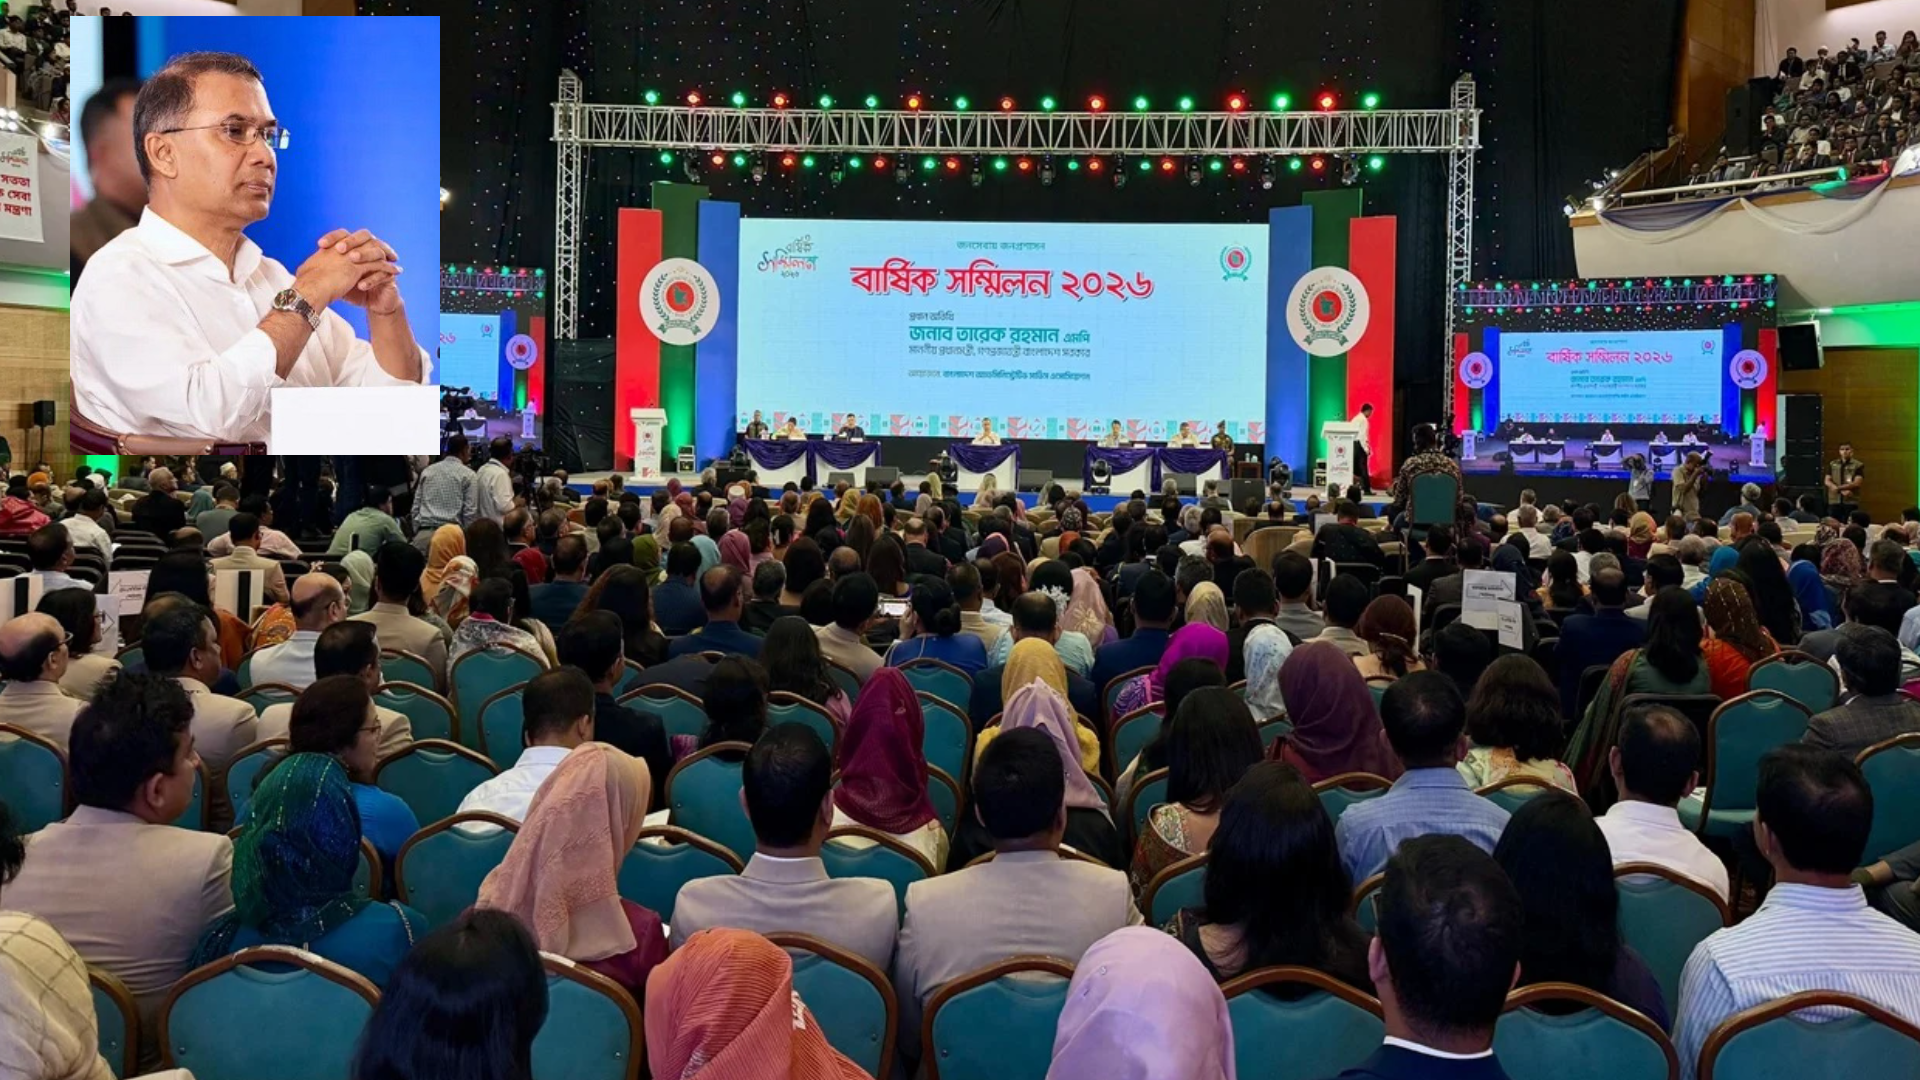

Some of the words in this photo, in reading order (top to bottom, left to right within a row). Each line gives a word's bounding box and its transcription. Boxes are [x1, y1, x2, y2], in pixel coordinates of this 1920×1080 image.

[849, 257, 939, 296] বার্ষিক
[945, 258, 1052, 298] সম্মিলন
[1061, 270, 1154, 301] ২০২৬
[909, 325, 953, 342] জনাব
[956, 326, 1006, 344] তারেক
[1009, 327, 1059, 344] রহমান
[1063, 330, 1090, 343] এমপি
[1546, 347, 1582, 364] বার্ষিক
[1634, 350, 1673, 365] ২০২৬
